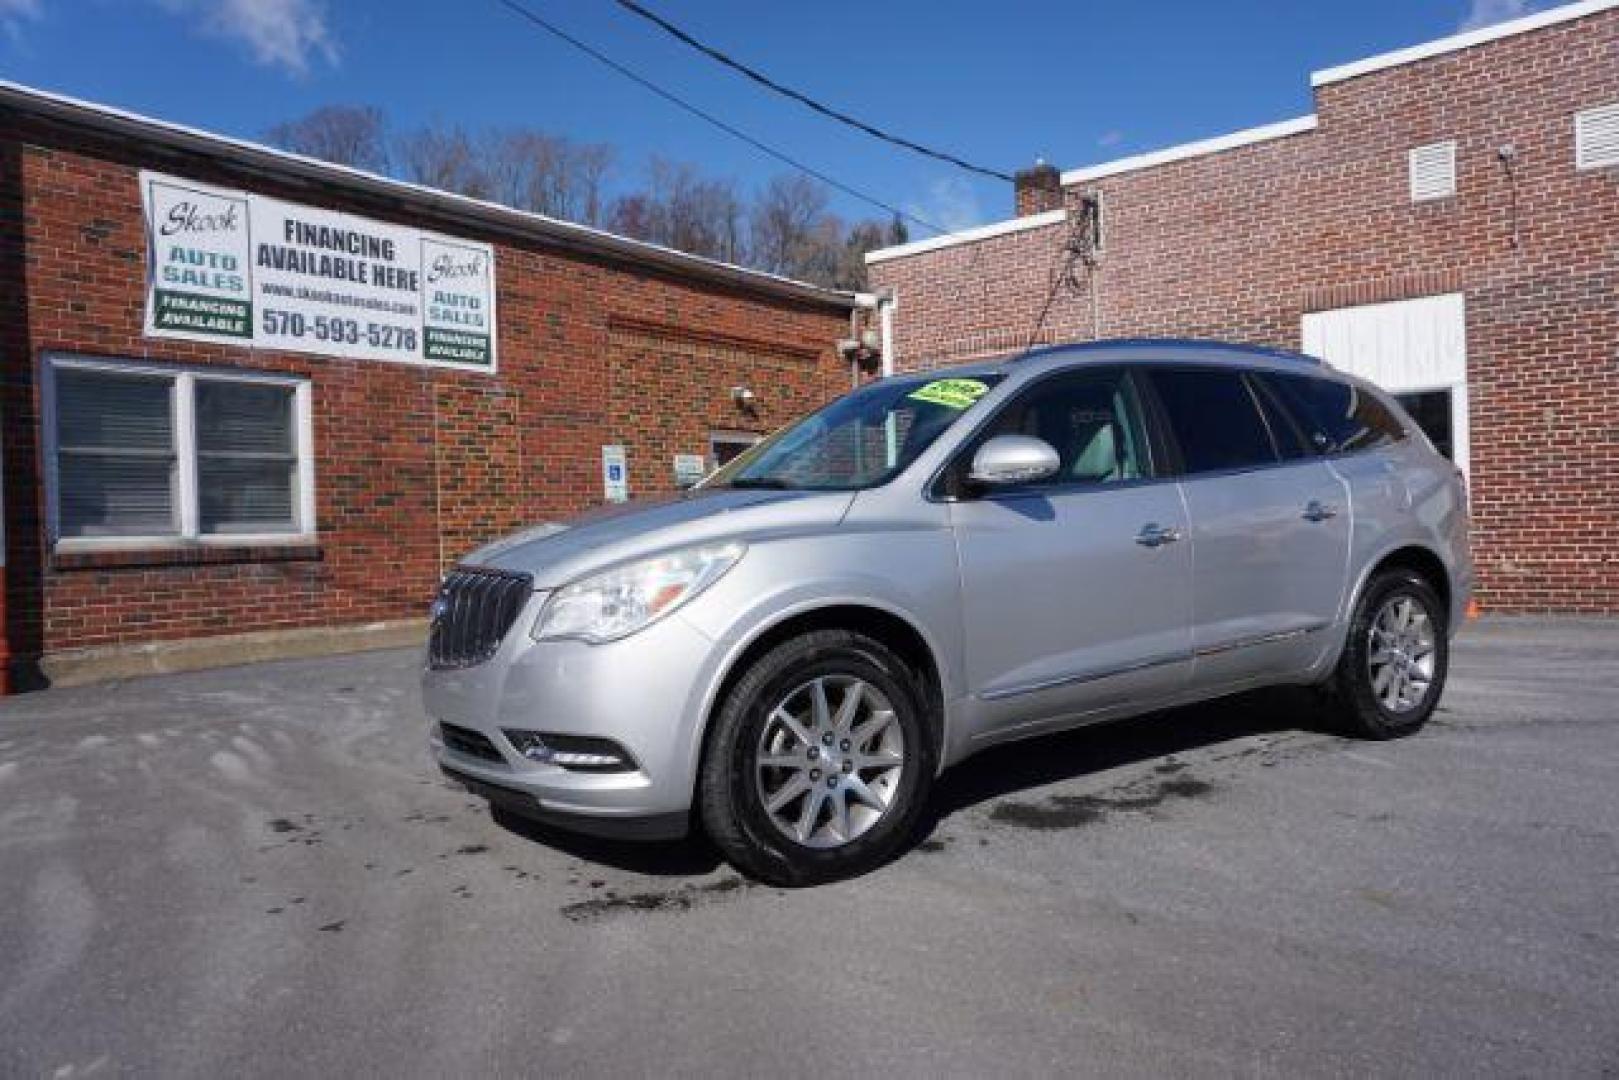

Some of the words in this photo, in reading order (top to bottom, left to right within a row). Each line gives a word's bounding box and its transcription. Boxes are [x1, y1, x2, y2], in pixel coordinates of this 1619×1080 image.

[160, 201, 239, 236] Skook
[285, 219, 394, 261] FINANCING
[170, 246, 236, 271] AUTO
[257, 243, 368, 284] AVAILABLE
[372, 264, 419, 292] HERE
[427, 254, 481, 283] Skook
[164, 265, 243, 292] SALES
[163, 296, 246, 317] FINANCING
[433, 290, 480, 309] AUTO
[162, 314, 245, 332] AVAILABLE
[429, 306, 483, 326] SALES
[262, 308, 417, 352] 570-593-5278
